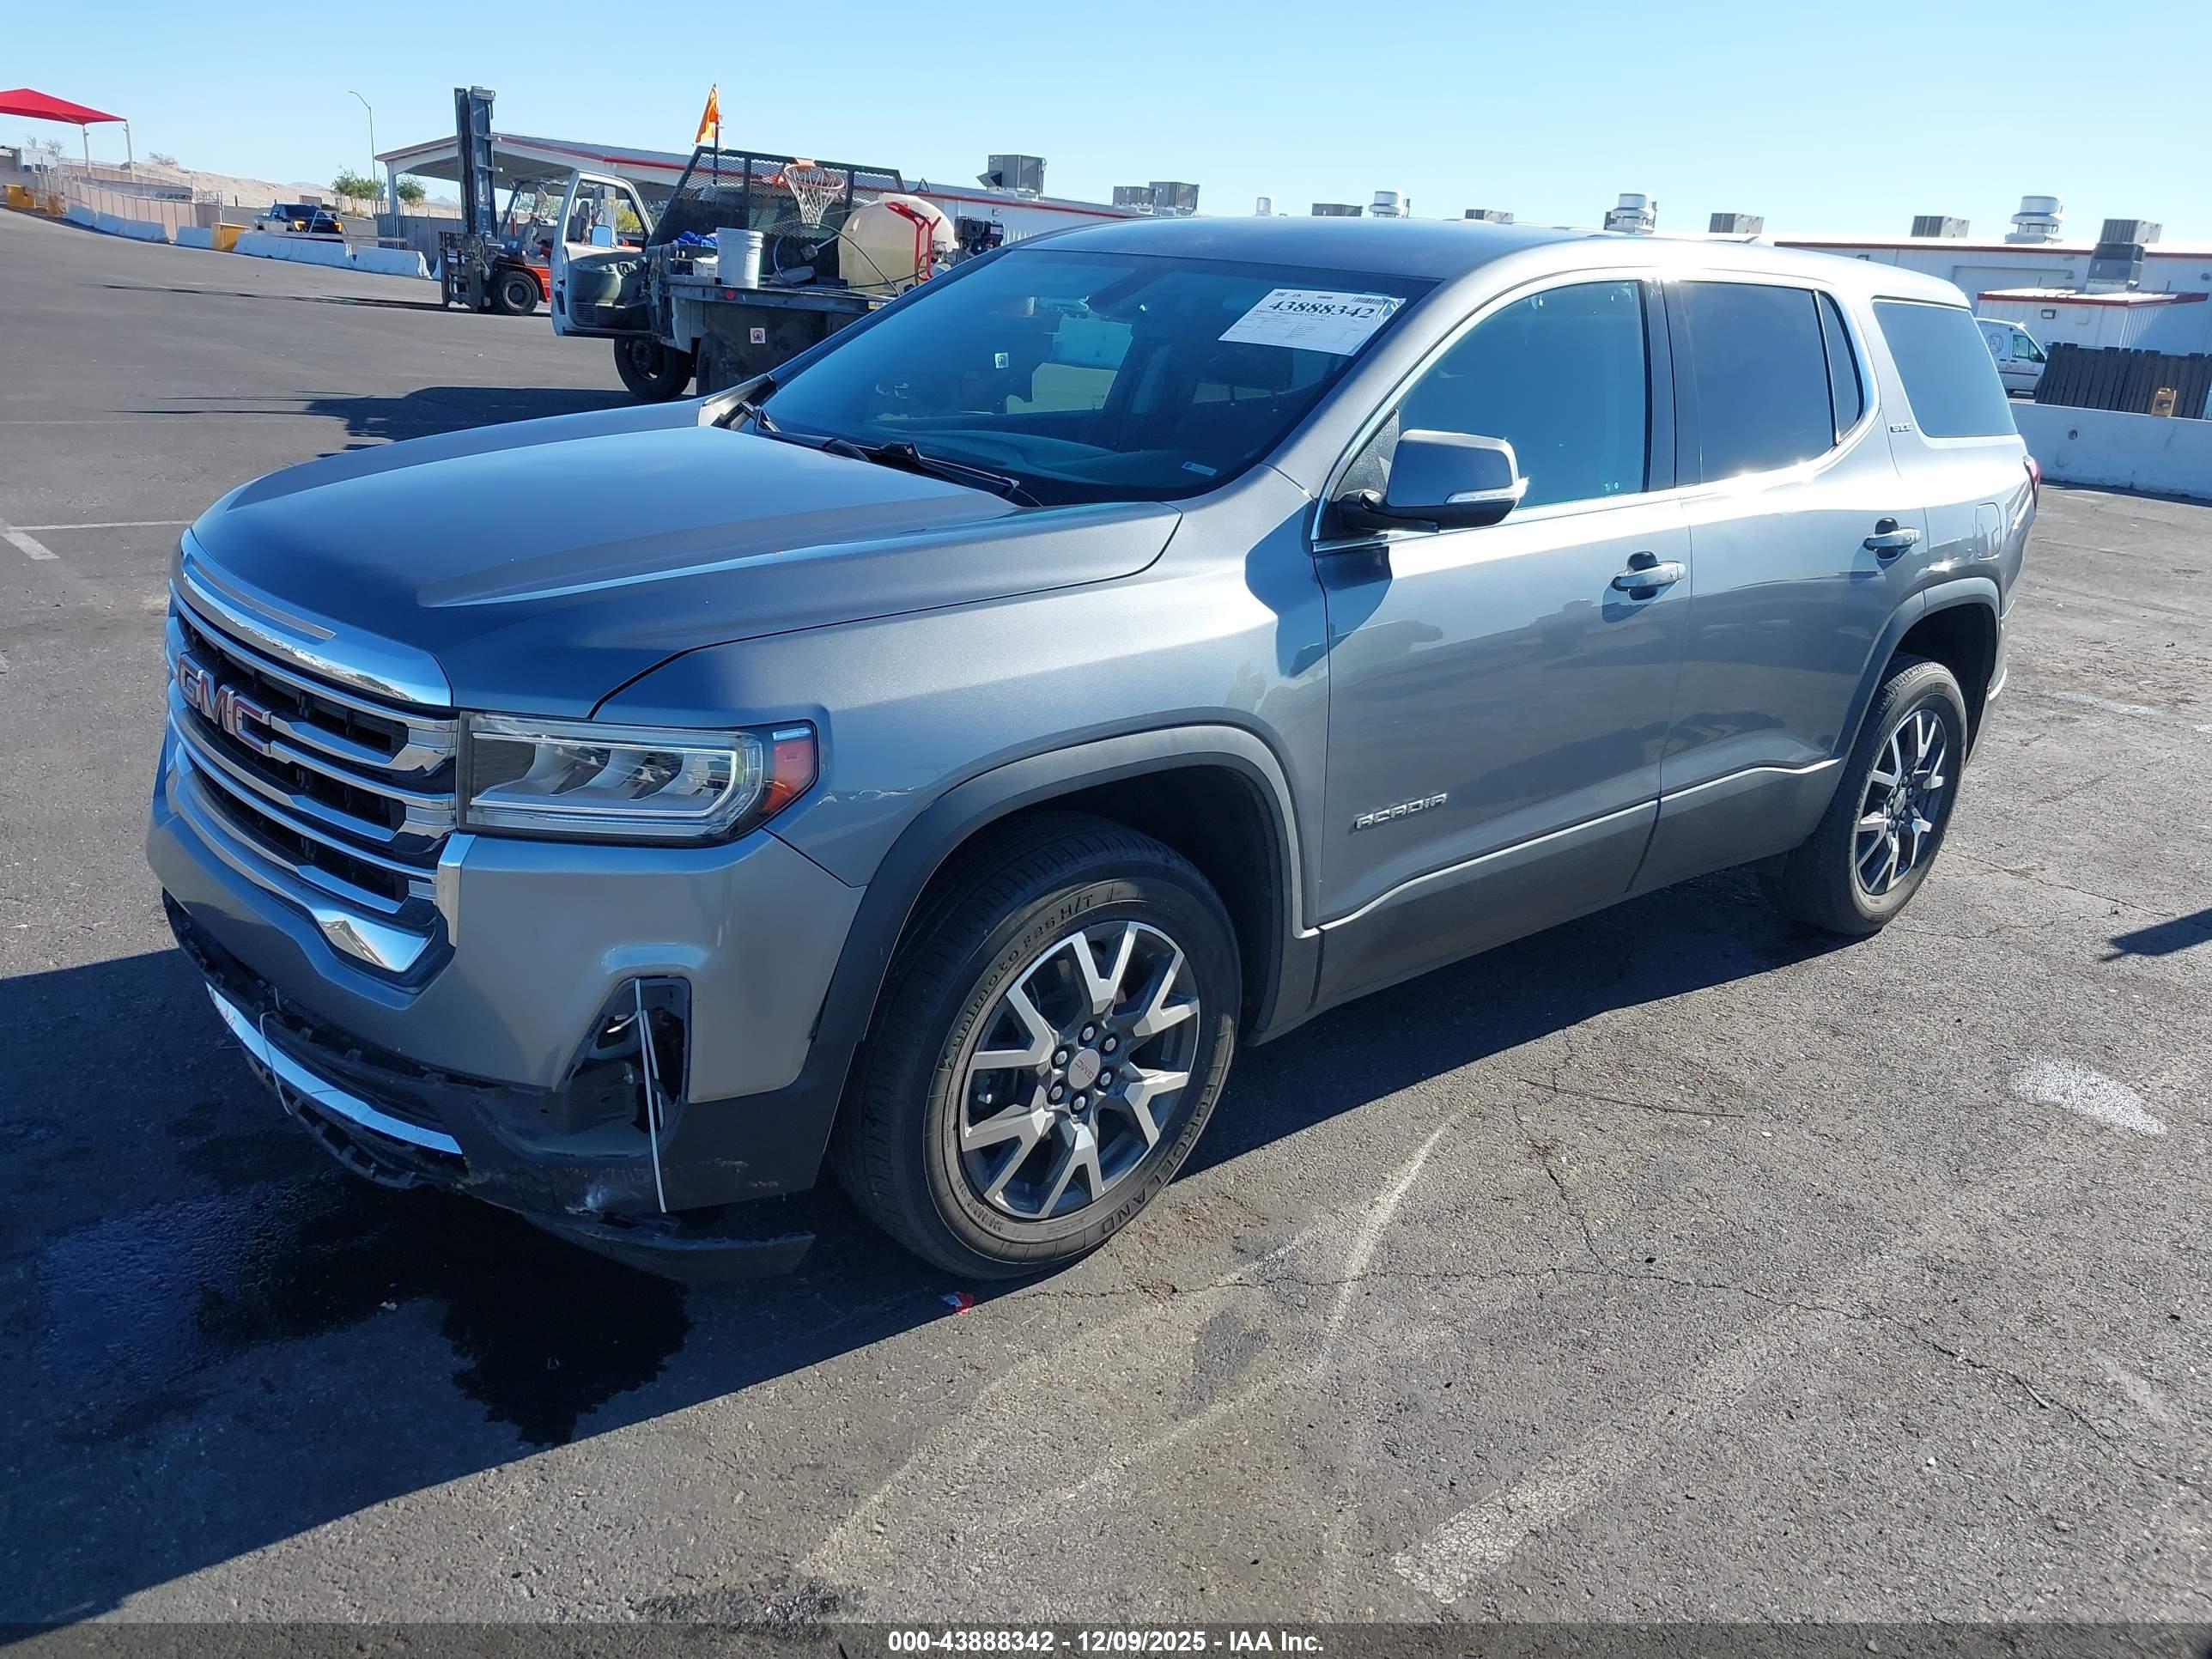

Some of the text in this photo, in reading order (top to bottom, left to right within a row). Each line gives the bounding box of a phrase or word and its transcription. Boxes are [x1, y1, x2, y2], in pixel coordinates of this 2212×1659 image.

[1268, 301, 1375, 319] 43888342
[179, 653, 271, 757] GMC
[1356, 793, 1447, 829] ACADIA
[1061, 894, 1093, 920] H/T
[1075, 1059, 1095, 1079] GMC
